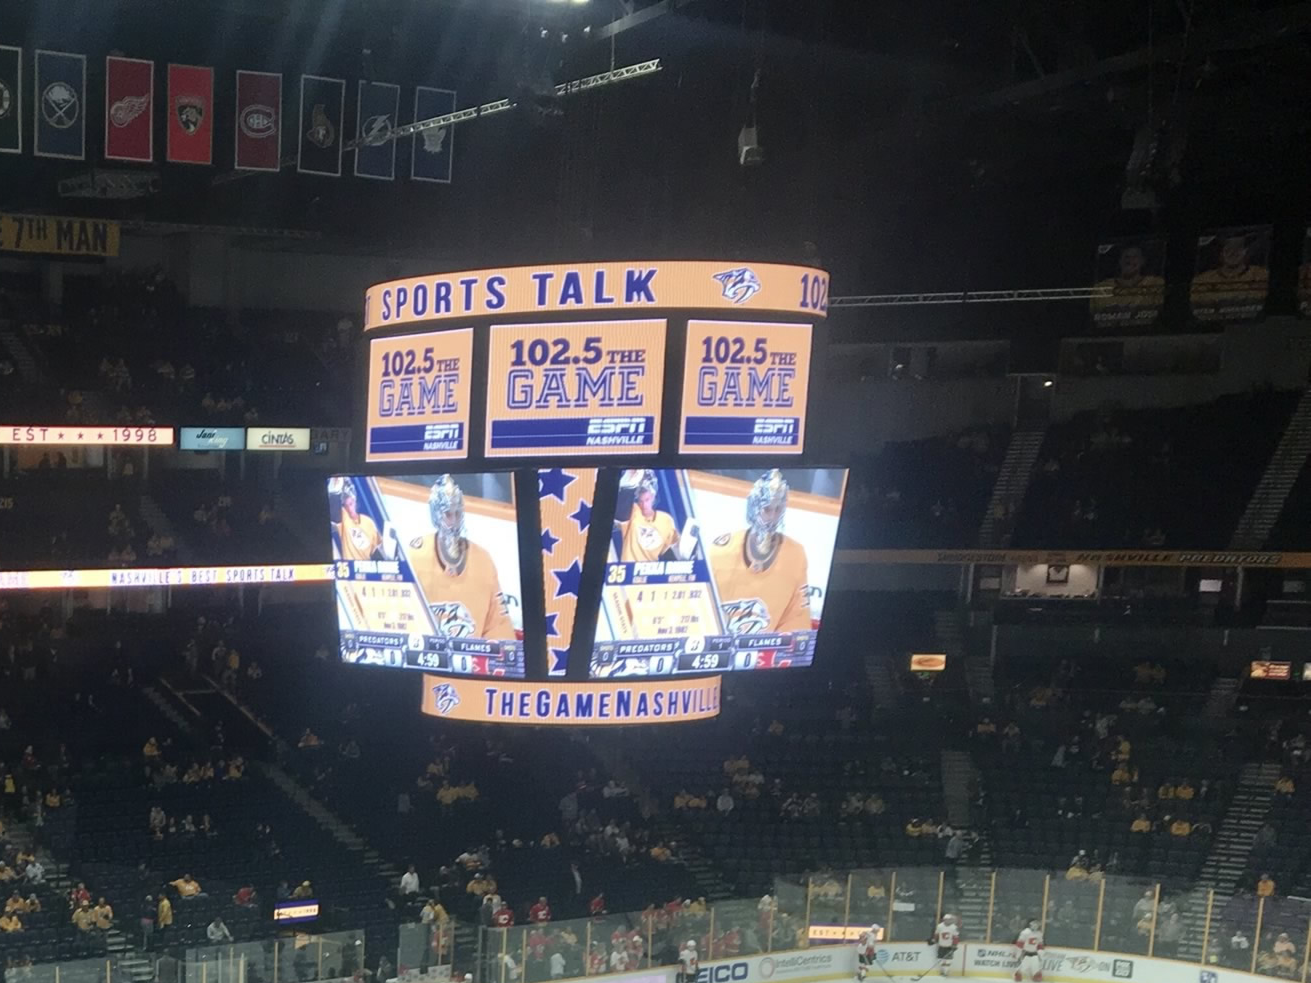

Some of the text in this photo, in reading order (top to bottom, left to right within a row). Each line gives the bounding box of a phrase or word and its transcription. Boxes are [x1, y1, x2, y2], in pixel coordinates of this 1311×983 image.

[13, 216, 48, 248] 7TH
[56, 220, 108, 252] MAN
[382, 276, 507, 322] SPORTS
[532, 268, 659, 306] TALK
[510, 336, 646, 368] 102.5 THE
[701, 336, 796, 366] 102.5 THE
[382, 347, 461, 376] 102.5 THE
[379, 374, 459, 418] GAME
[507, 366, 644, 410] GAME
[697, 366, 795, 409] GAME
[12, 428, 158, 442] EST 1998
[424, 423, 459, 441] ESPN
[587, 417, 646, 435] ESPN
[754, 418, 795, 435] ESPN
[423, 439, 458, 450] NASHVILLE
[586, 434, 644, 446] NASHVILLE
[753, 434, 792, 446] NASHVILLE
[191, 570, 217, 583] BEST
[608, 565, 626, 583] 35
[359, 635, 398, 646] PREDATORS
[460, 643, 491, 653] FLAMES
[620, 643, 673, 655] PREDATORS
[748, 637, 782, 647] FLAMES
[417, 653, 439, 668] 4:59
[691, 654, 719, 670] 4:59
[892, 951, 921, 962] AT&T
